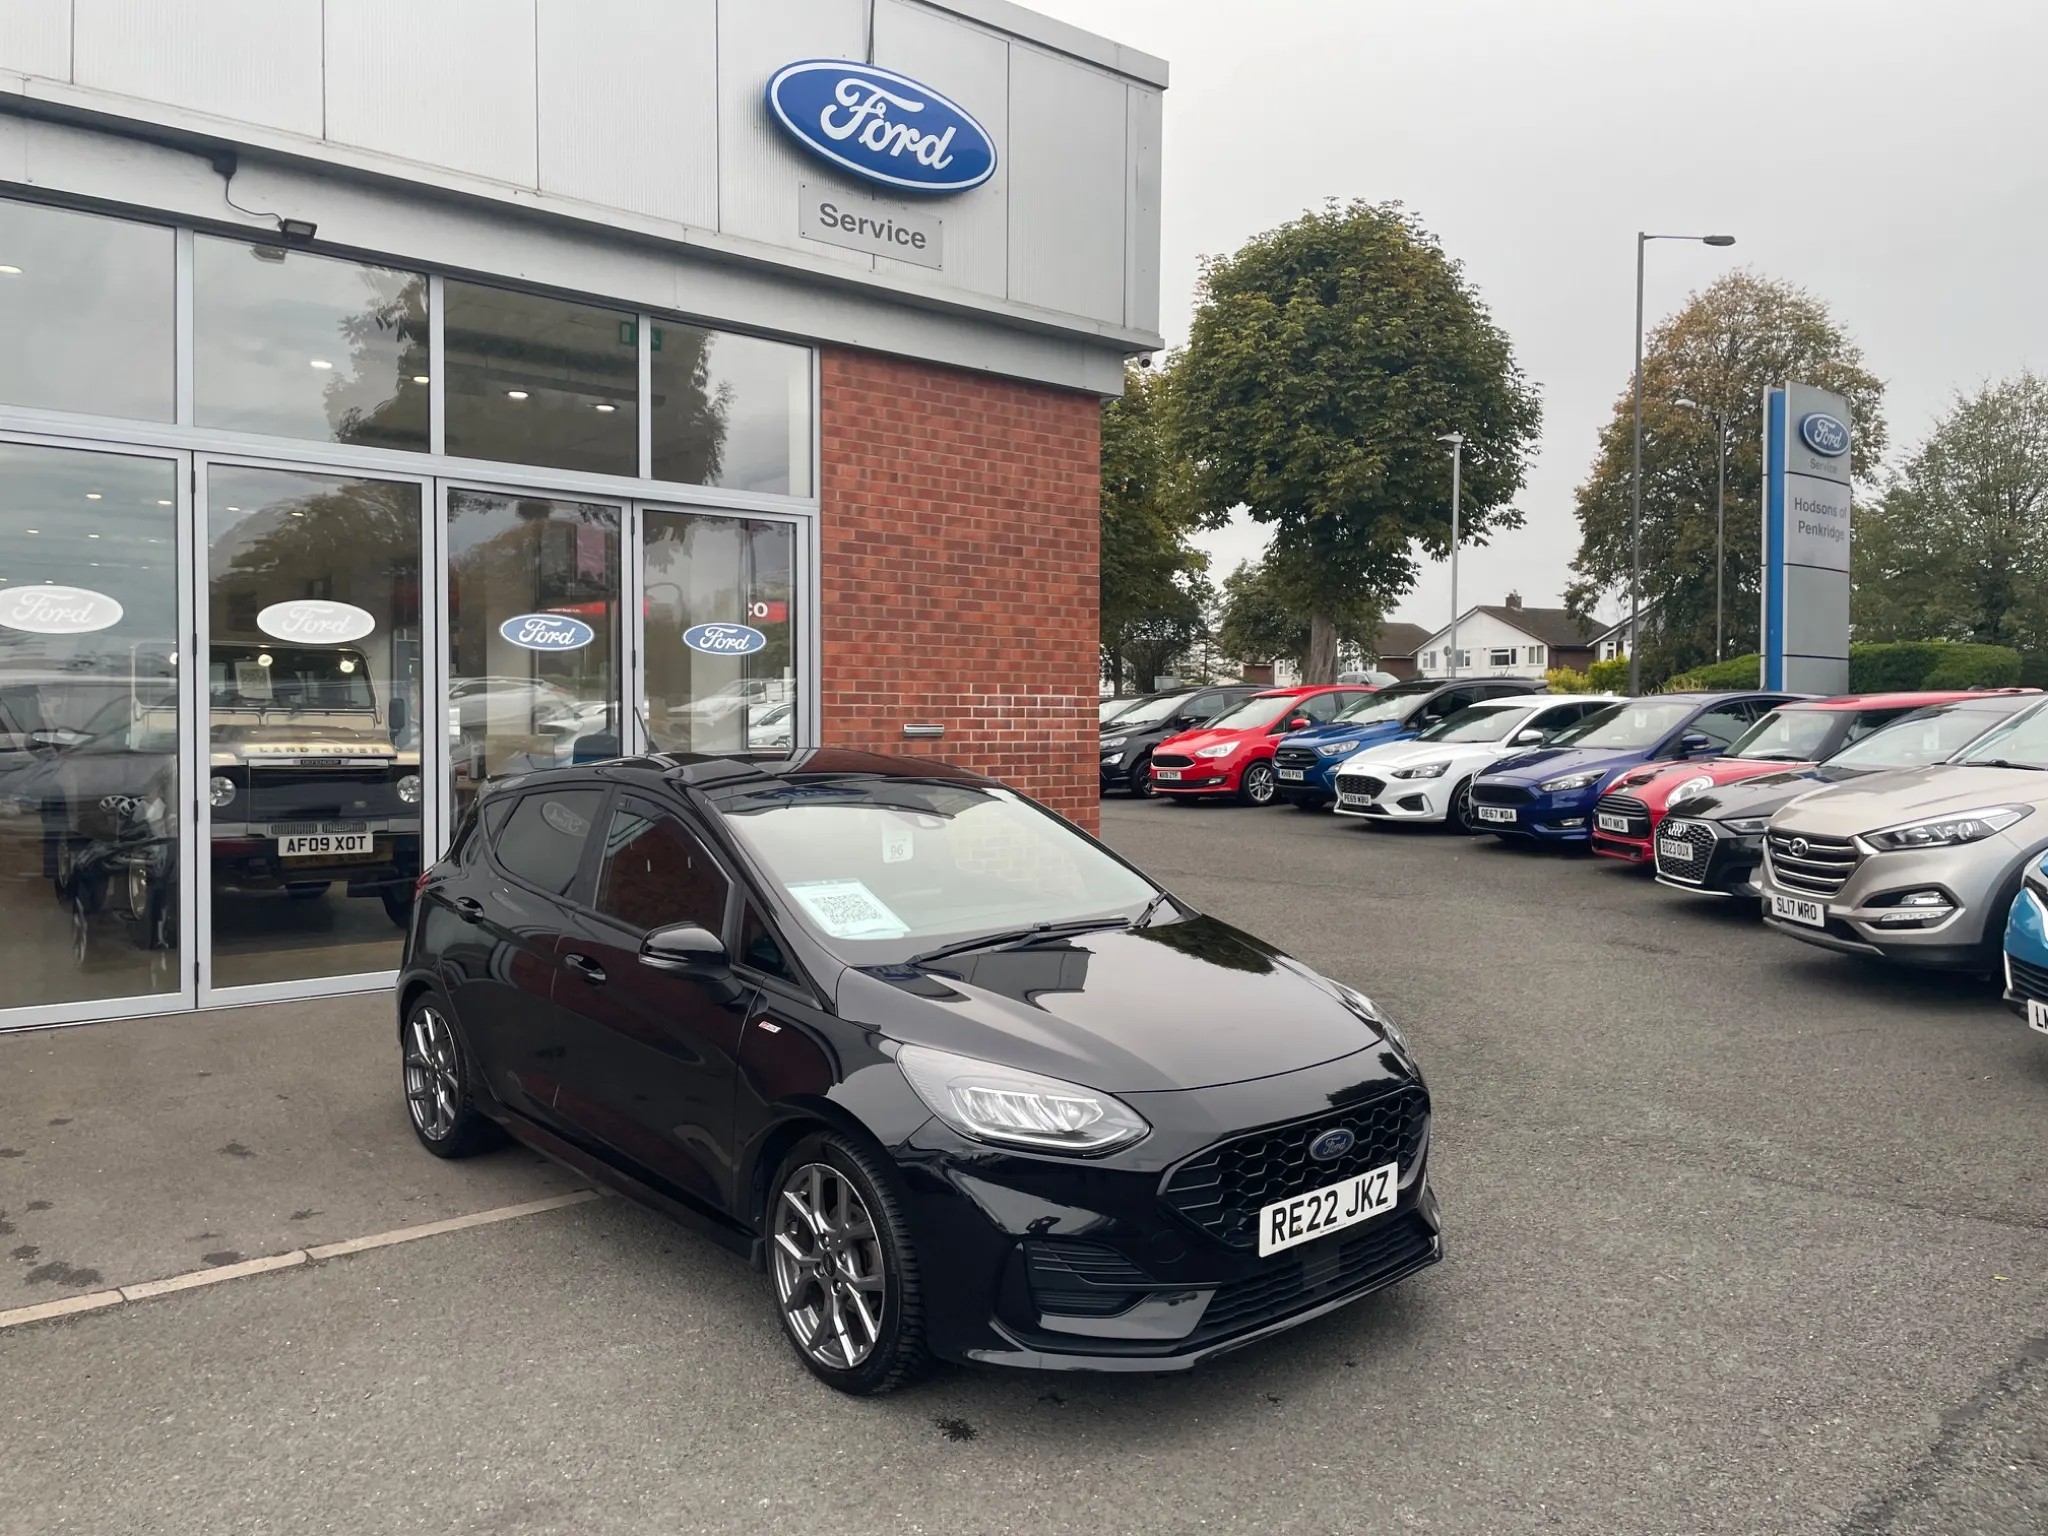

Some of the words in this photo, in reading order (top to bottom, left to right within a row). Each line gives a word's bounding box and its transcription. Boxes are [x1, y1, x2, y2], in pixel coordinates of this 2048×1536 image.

[820, 78, 957, 170] Ford
[819, 202, 927, 250] Service
[1814, 419, 1842, 448] Ford
[1810, 458, 1838, 475] Service
[1794, 497, 1838, 518] Hodsons
[1839, 506, 1848, 519] of
[1798, 520, 1844, 543] Penkridge
[12, 592, 95, 624] Ford
[281, 606, 352, 634] Ford
[518, 620, 575, 646] Ford
[699, 626, 749, 651] Ford
[320, 747, 381, 755] ROVER
[286, 838, 330, 852] AF09
[335, 836, 366, 850] XOT
[1776, 896, 1795, 916] SL17
[2035, 1005, 2048, 1030] L
[1322, 1136, 1347, 1155] Ford
[1271, 1190, 1339, 1245] RE22
[1346, 1170, 1389, 1218] JKZ
